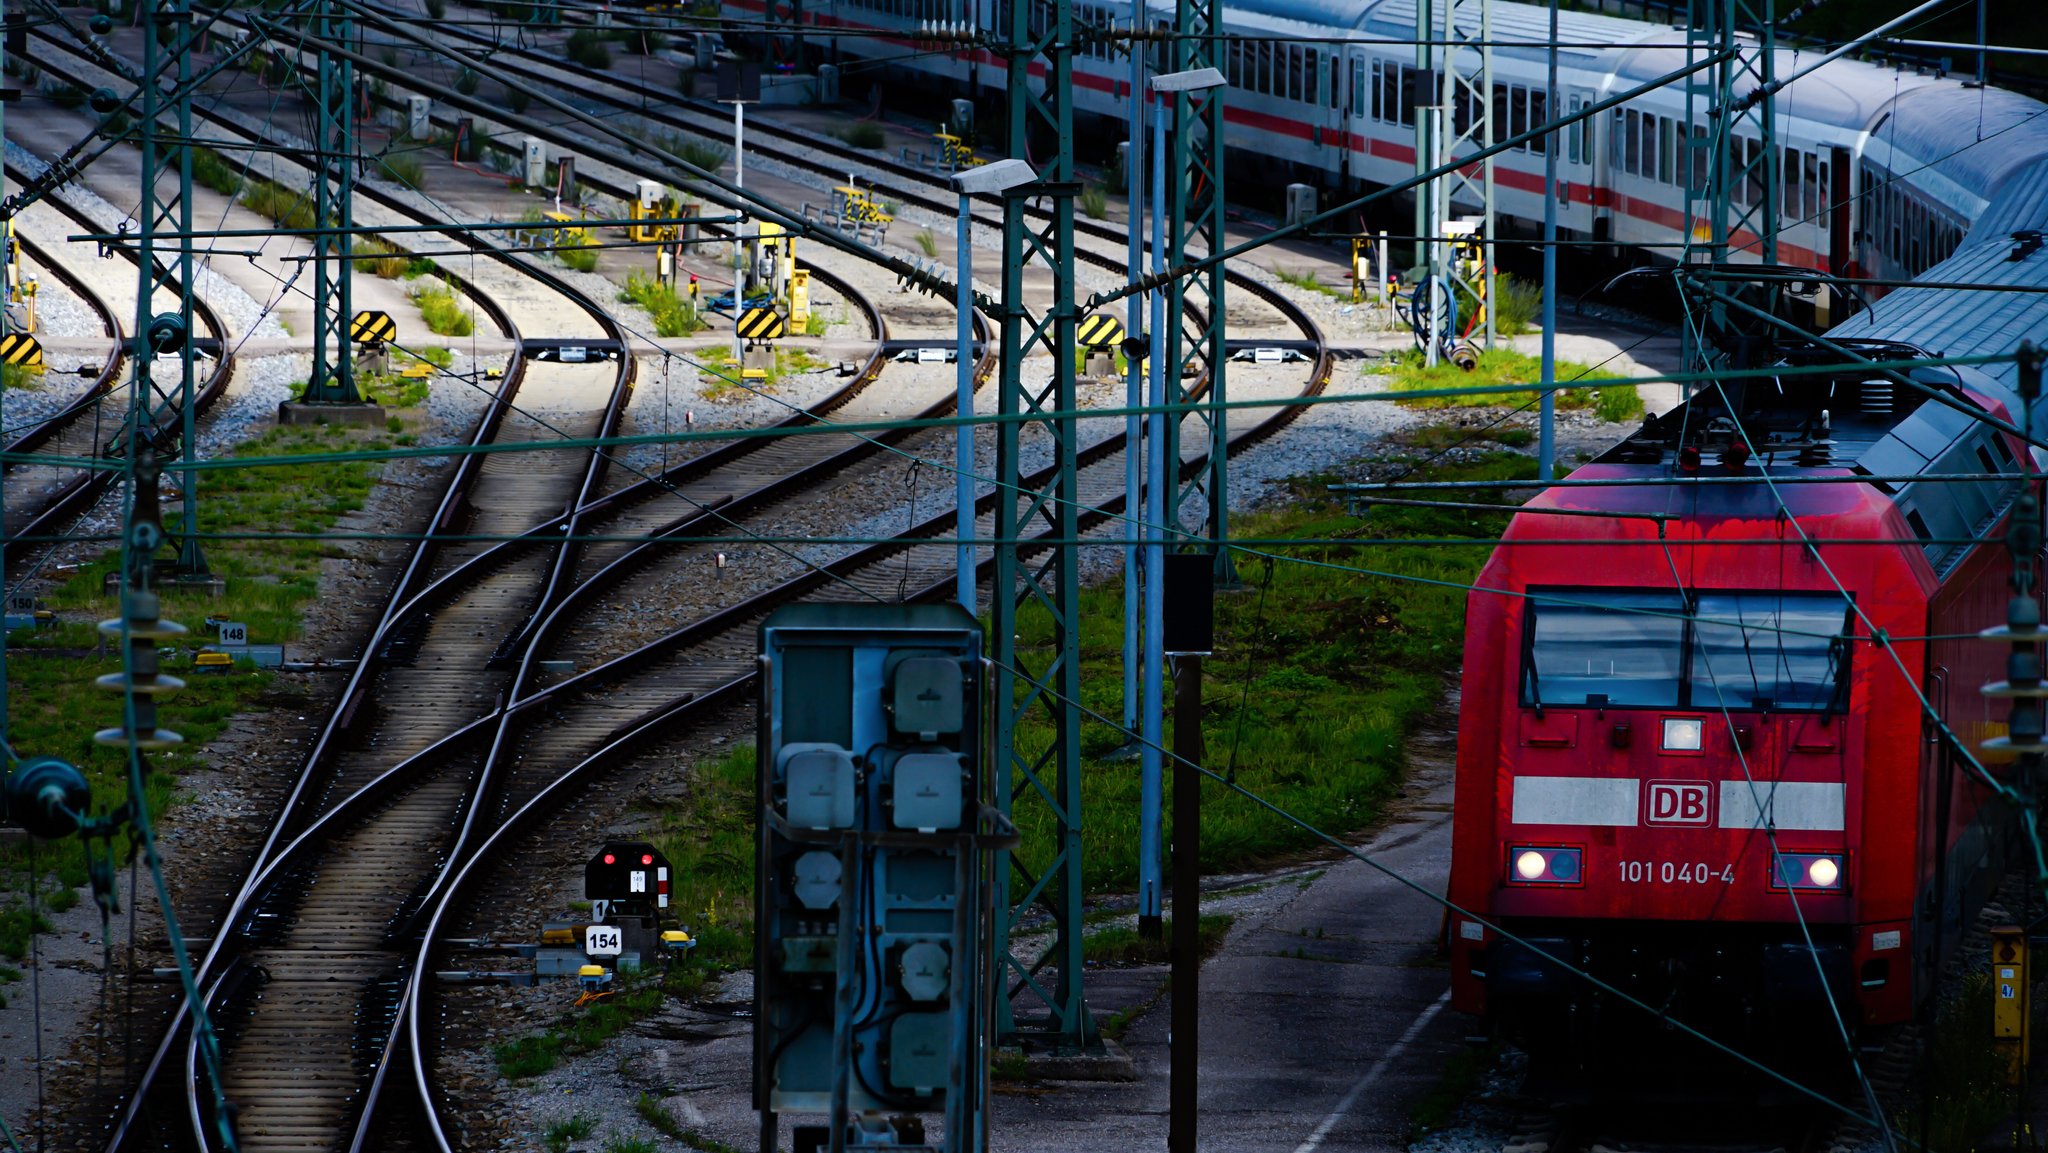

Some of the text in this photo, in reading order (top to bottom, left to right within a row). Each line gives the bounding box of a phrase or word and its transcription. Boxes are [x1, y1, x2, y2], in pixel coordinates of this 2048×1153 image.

[11, 598, 32, 609] 150
[222, 628, 244, 640] 148
[1654, 787, 1704, 819] DB
[1619, 861, 1735, 885] 101 040-4
[590, 933, 618, 948] 154
